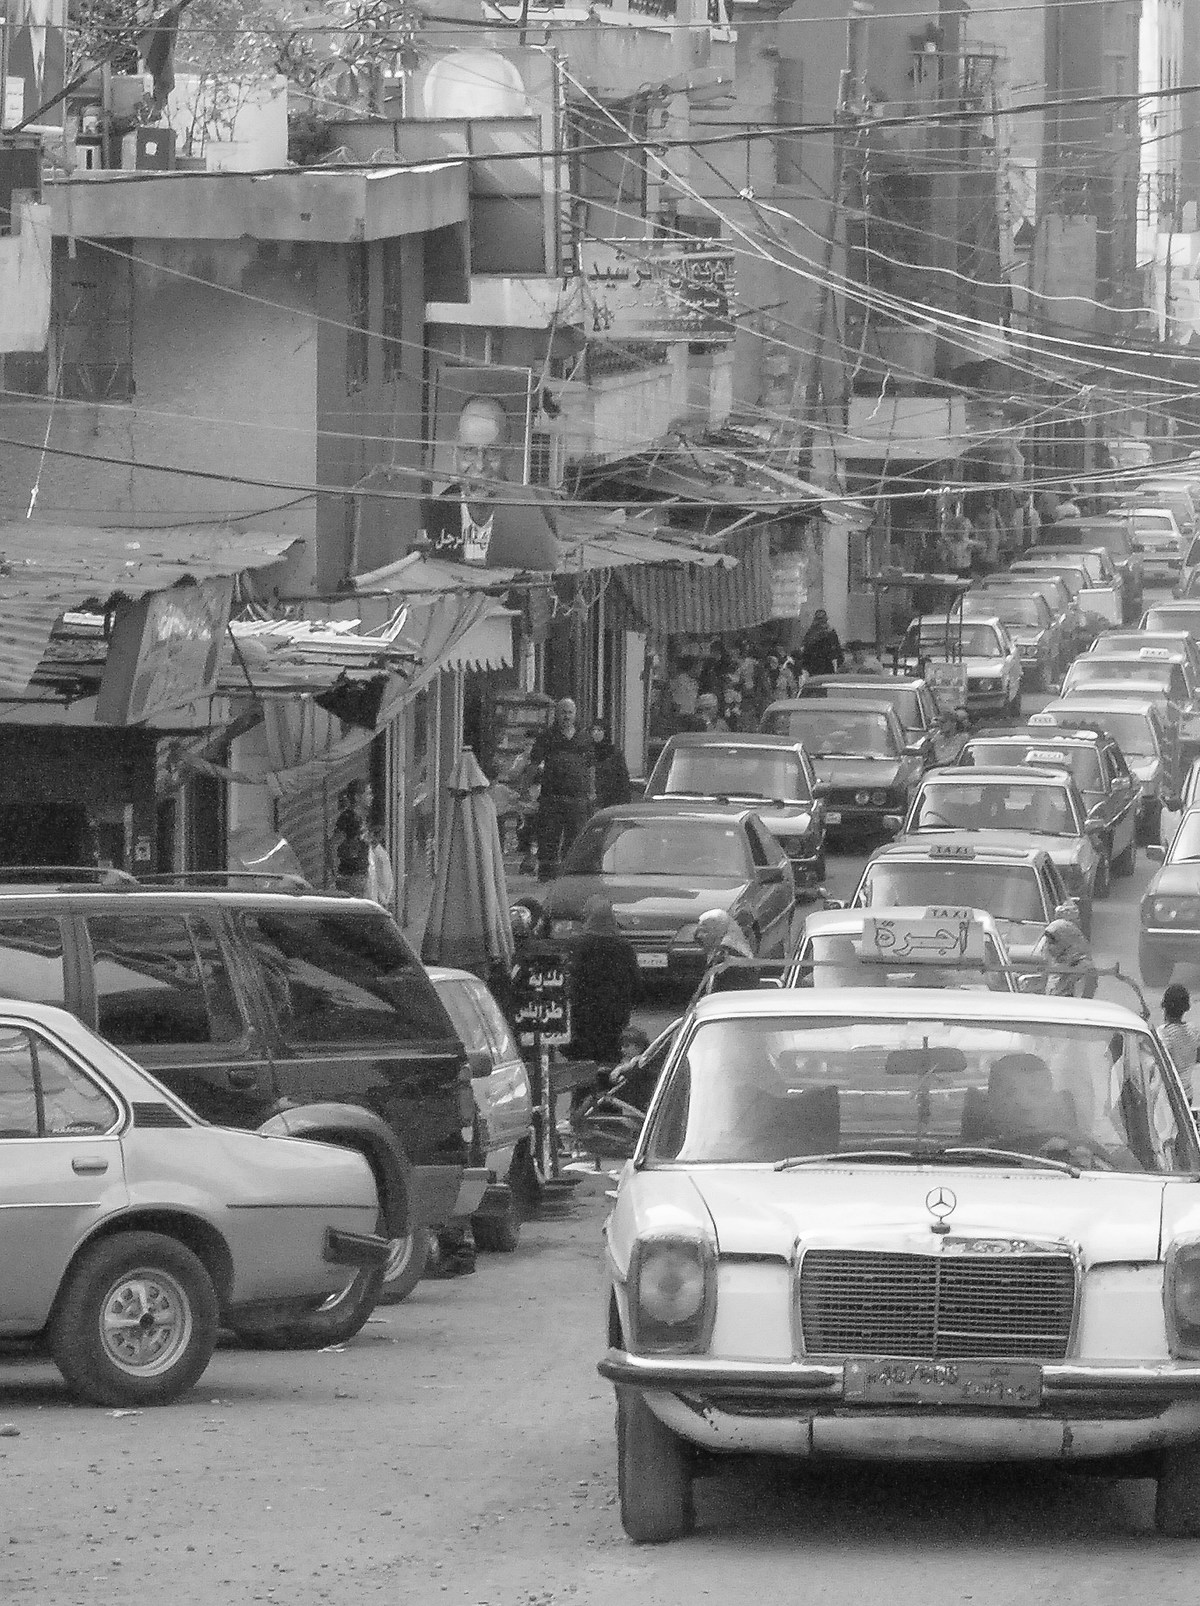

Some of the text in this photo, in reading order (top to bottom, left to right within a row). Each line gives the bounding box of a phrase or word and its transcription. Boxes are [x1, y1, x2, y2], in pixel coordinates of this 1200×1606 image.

[936, 845, 969, 855] TAXI
[932, 908, 968, 917] TAXI
[874, 920, 969, 956] أجرة
[528, 967, 563, 991] بلدية
[514, 1001, 563, 1023] طرابلس
